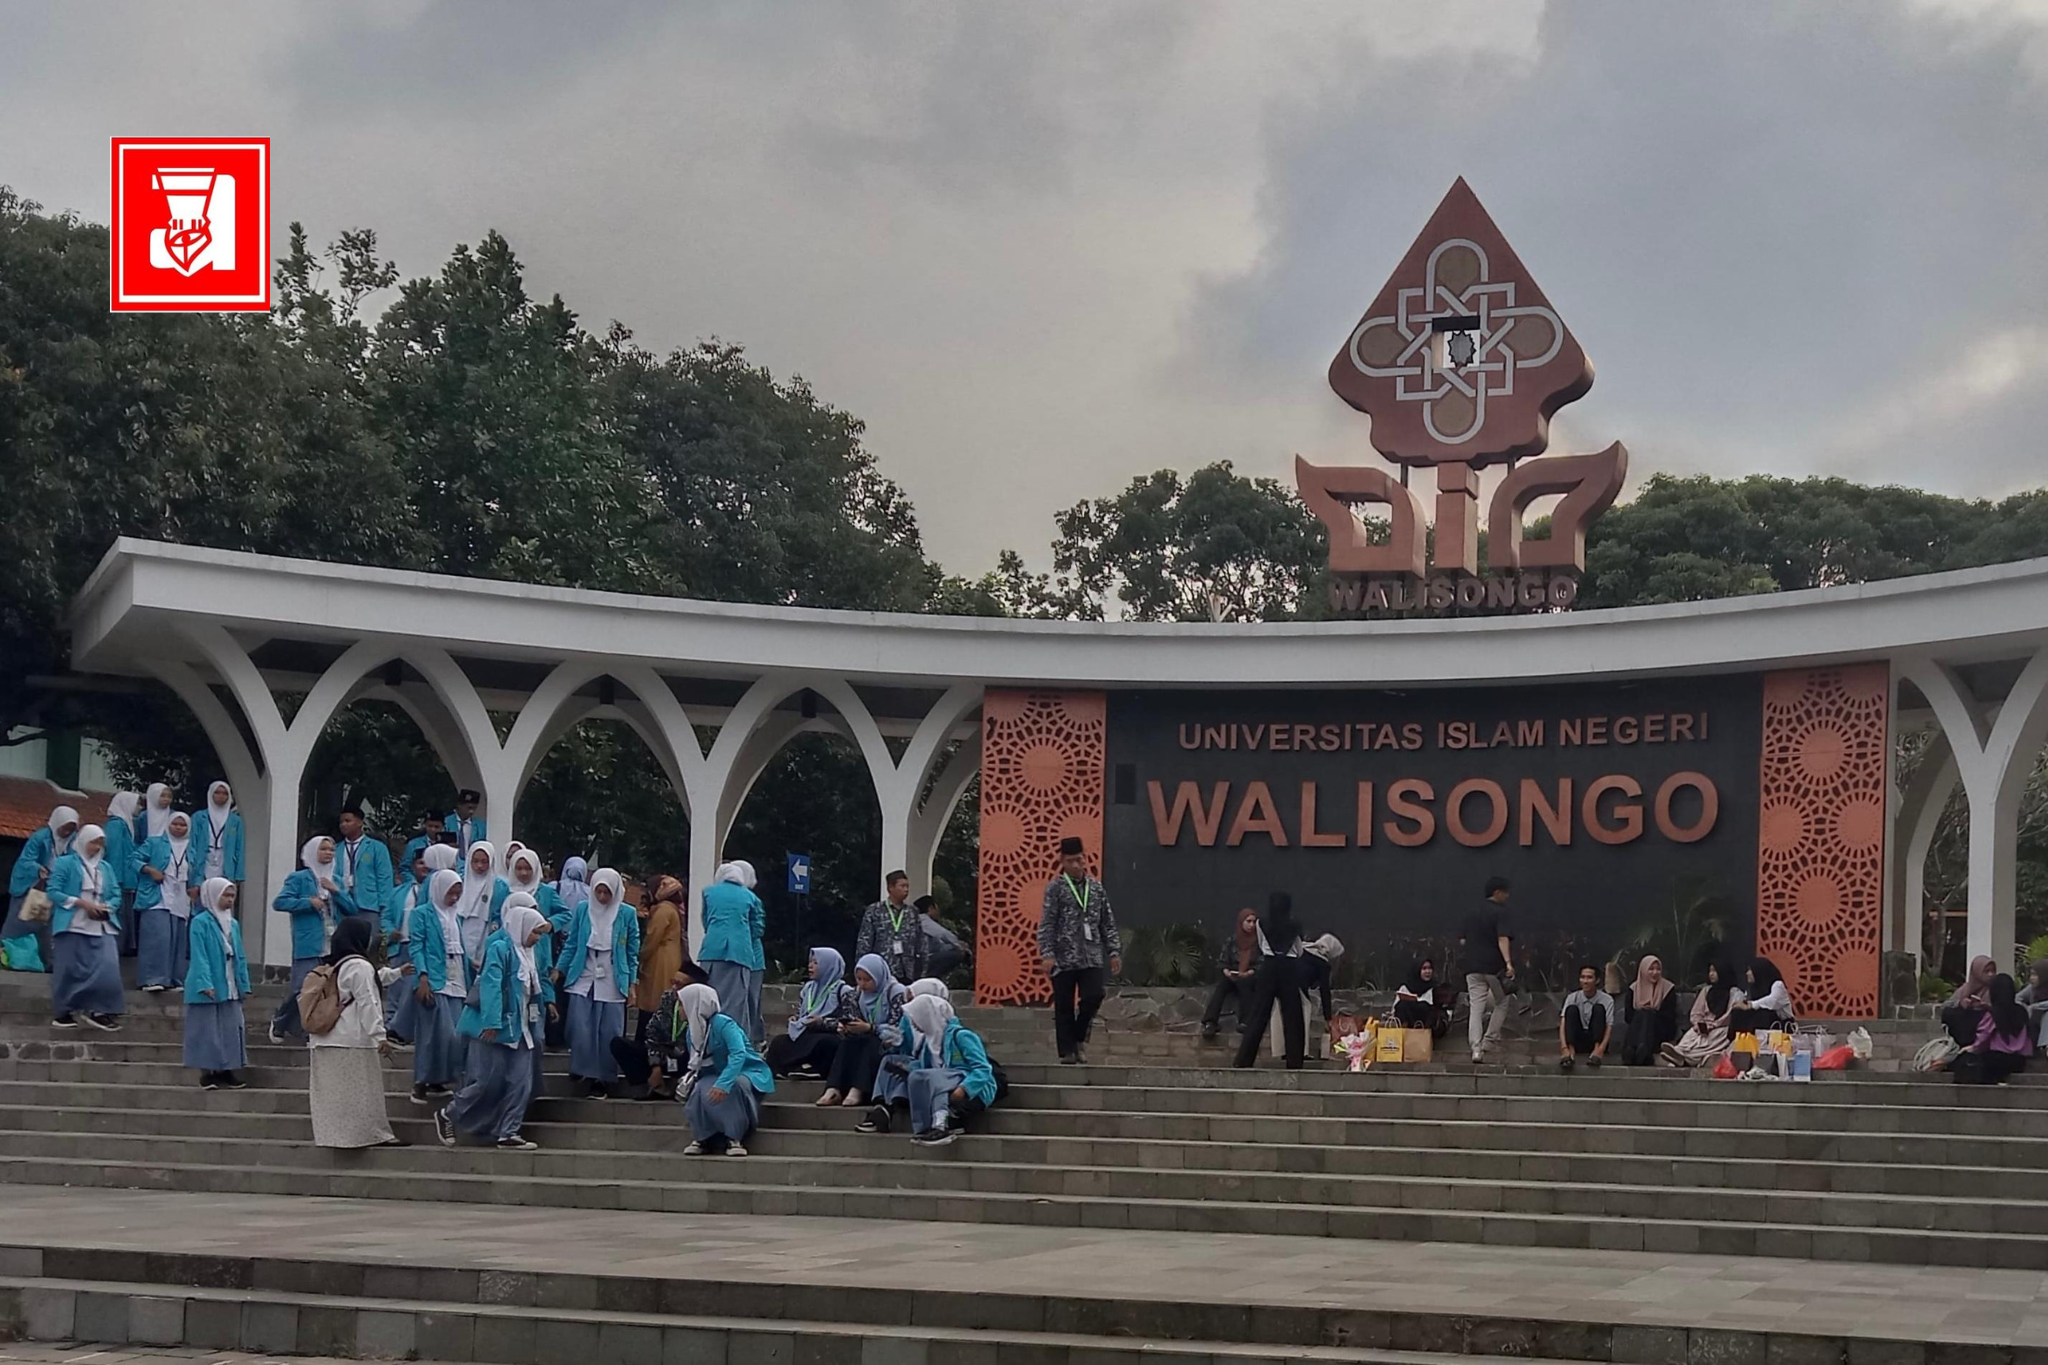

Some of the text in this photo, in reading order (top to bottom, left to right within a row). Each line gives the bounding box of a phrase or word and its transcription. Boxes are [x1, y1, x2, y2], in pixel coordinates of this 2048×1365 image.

[1330, 574, 1578, 611] WALISONGO
[1178, 711, 1709, 751] UNIVERSITAS ISLAM NEGERI
[1146, 770, 1720, 848] WALISONGO
